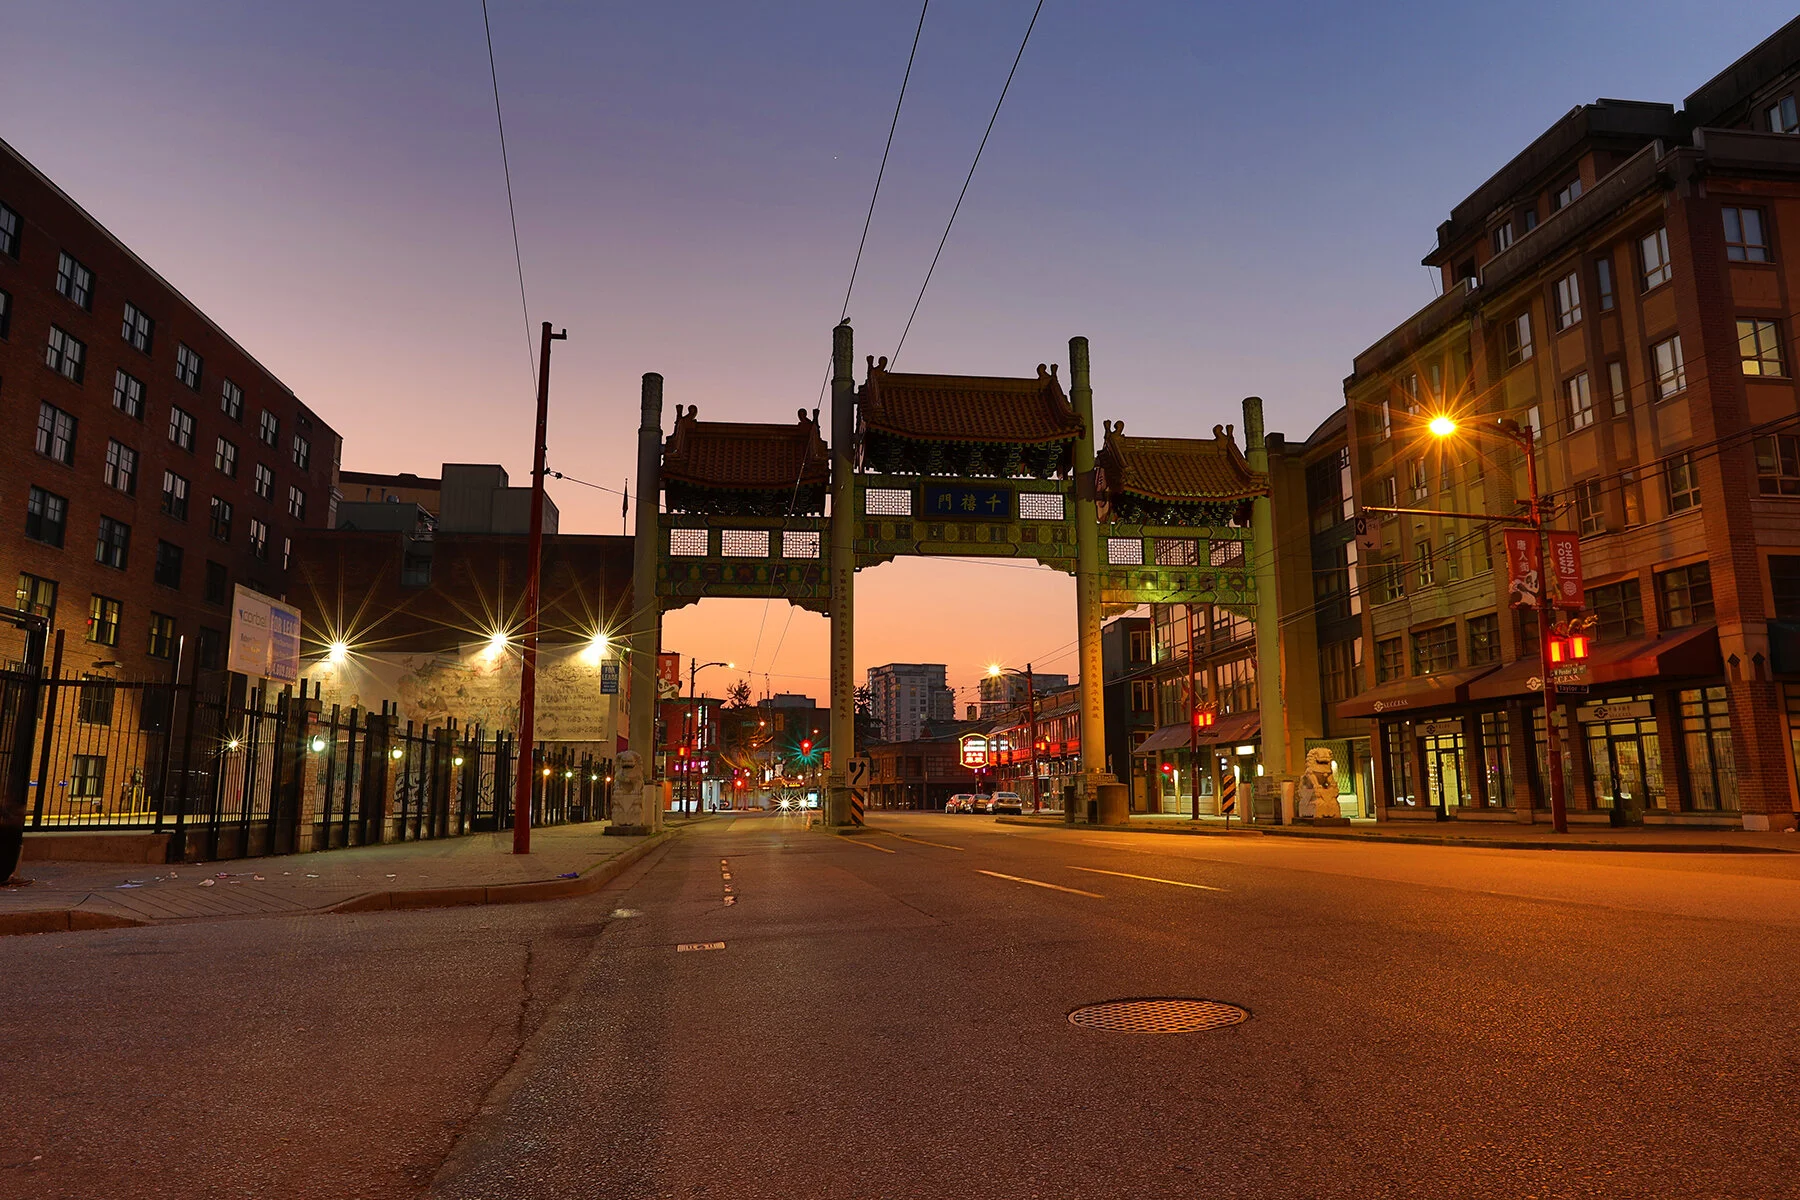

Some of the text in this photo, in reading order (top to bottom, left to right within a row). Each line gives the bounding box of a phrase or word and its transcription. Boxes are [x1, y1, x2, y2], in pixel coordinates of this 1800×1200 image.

[1516, 539, 1530, 573] 唐人街
[1556, 541, 1568, 574] TOWN
[1564, 541, 1576, 575] CHINA
[1559, 685, 1578, 693] Taylor
